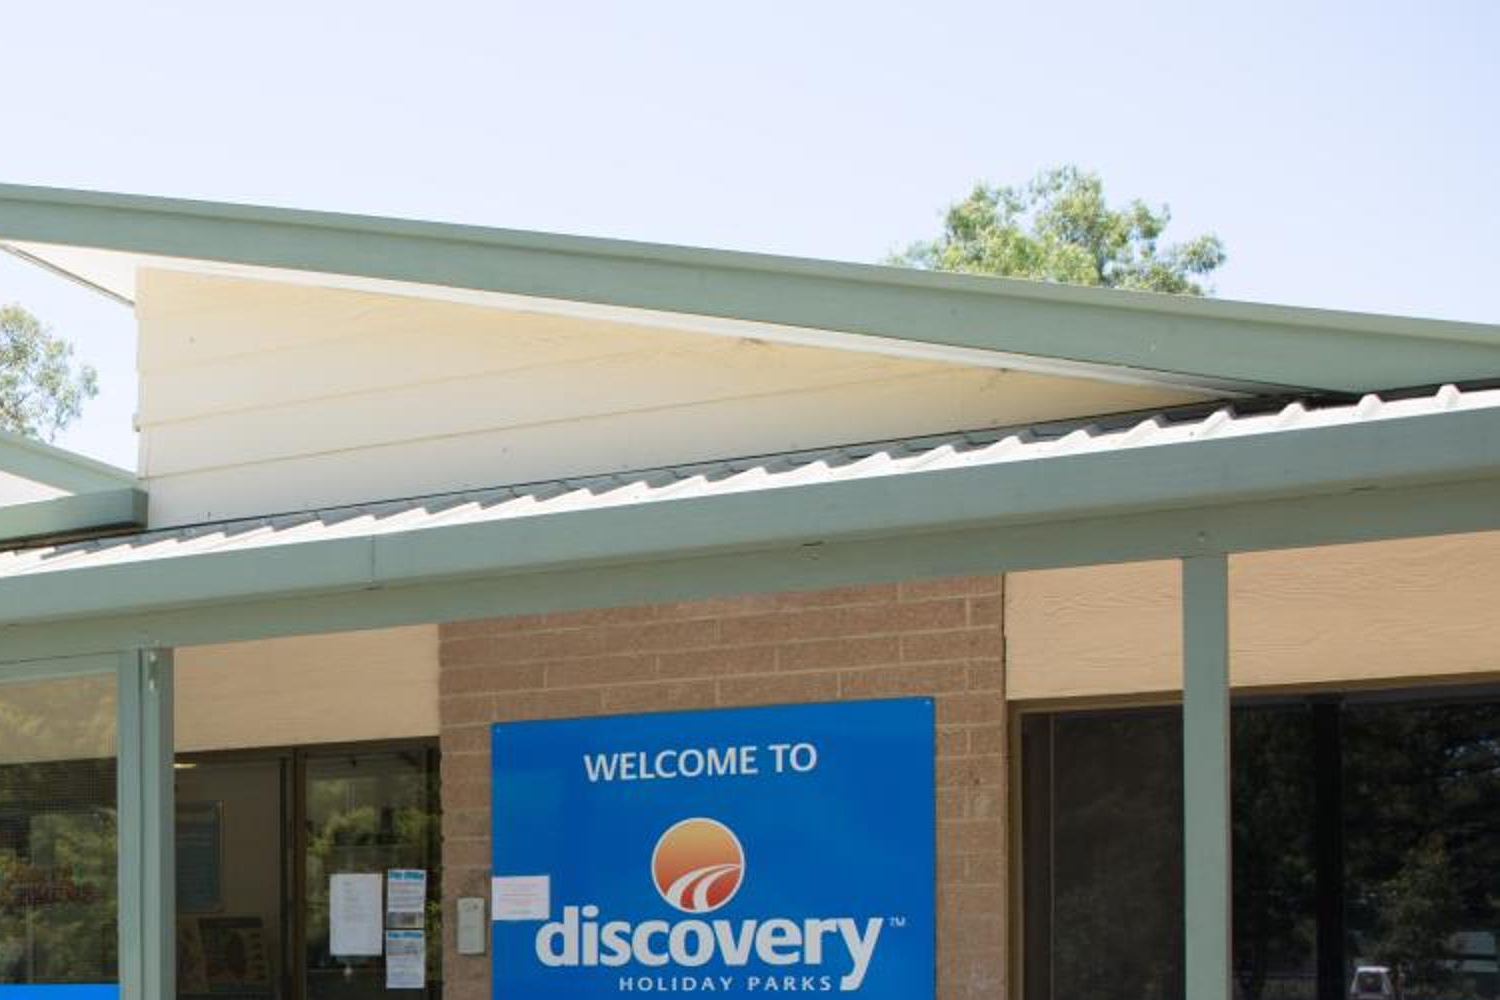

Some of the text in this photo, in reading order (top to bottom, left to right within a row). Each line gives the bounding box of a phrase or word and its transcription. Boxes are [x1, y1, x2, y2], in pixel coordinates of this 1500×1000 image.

[584, 743, 818, 782] WELCOME TO
[534, 905, 884, 991] discovery
[619, 975, 831, 992] HOLIDAY PARKS
